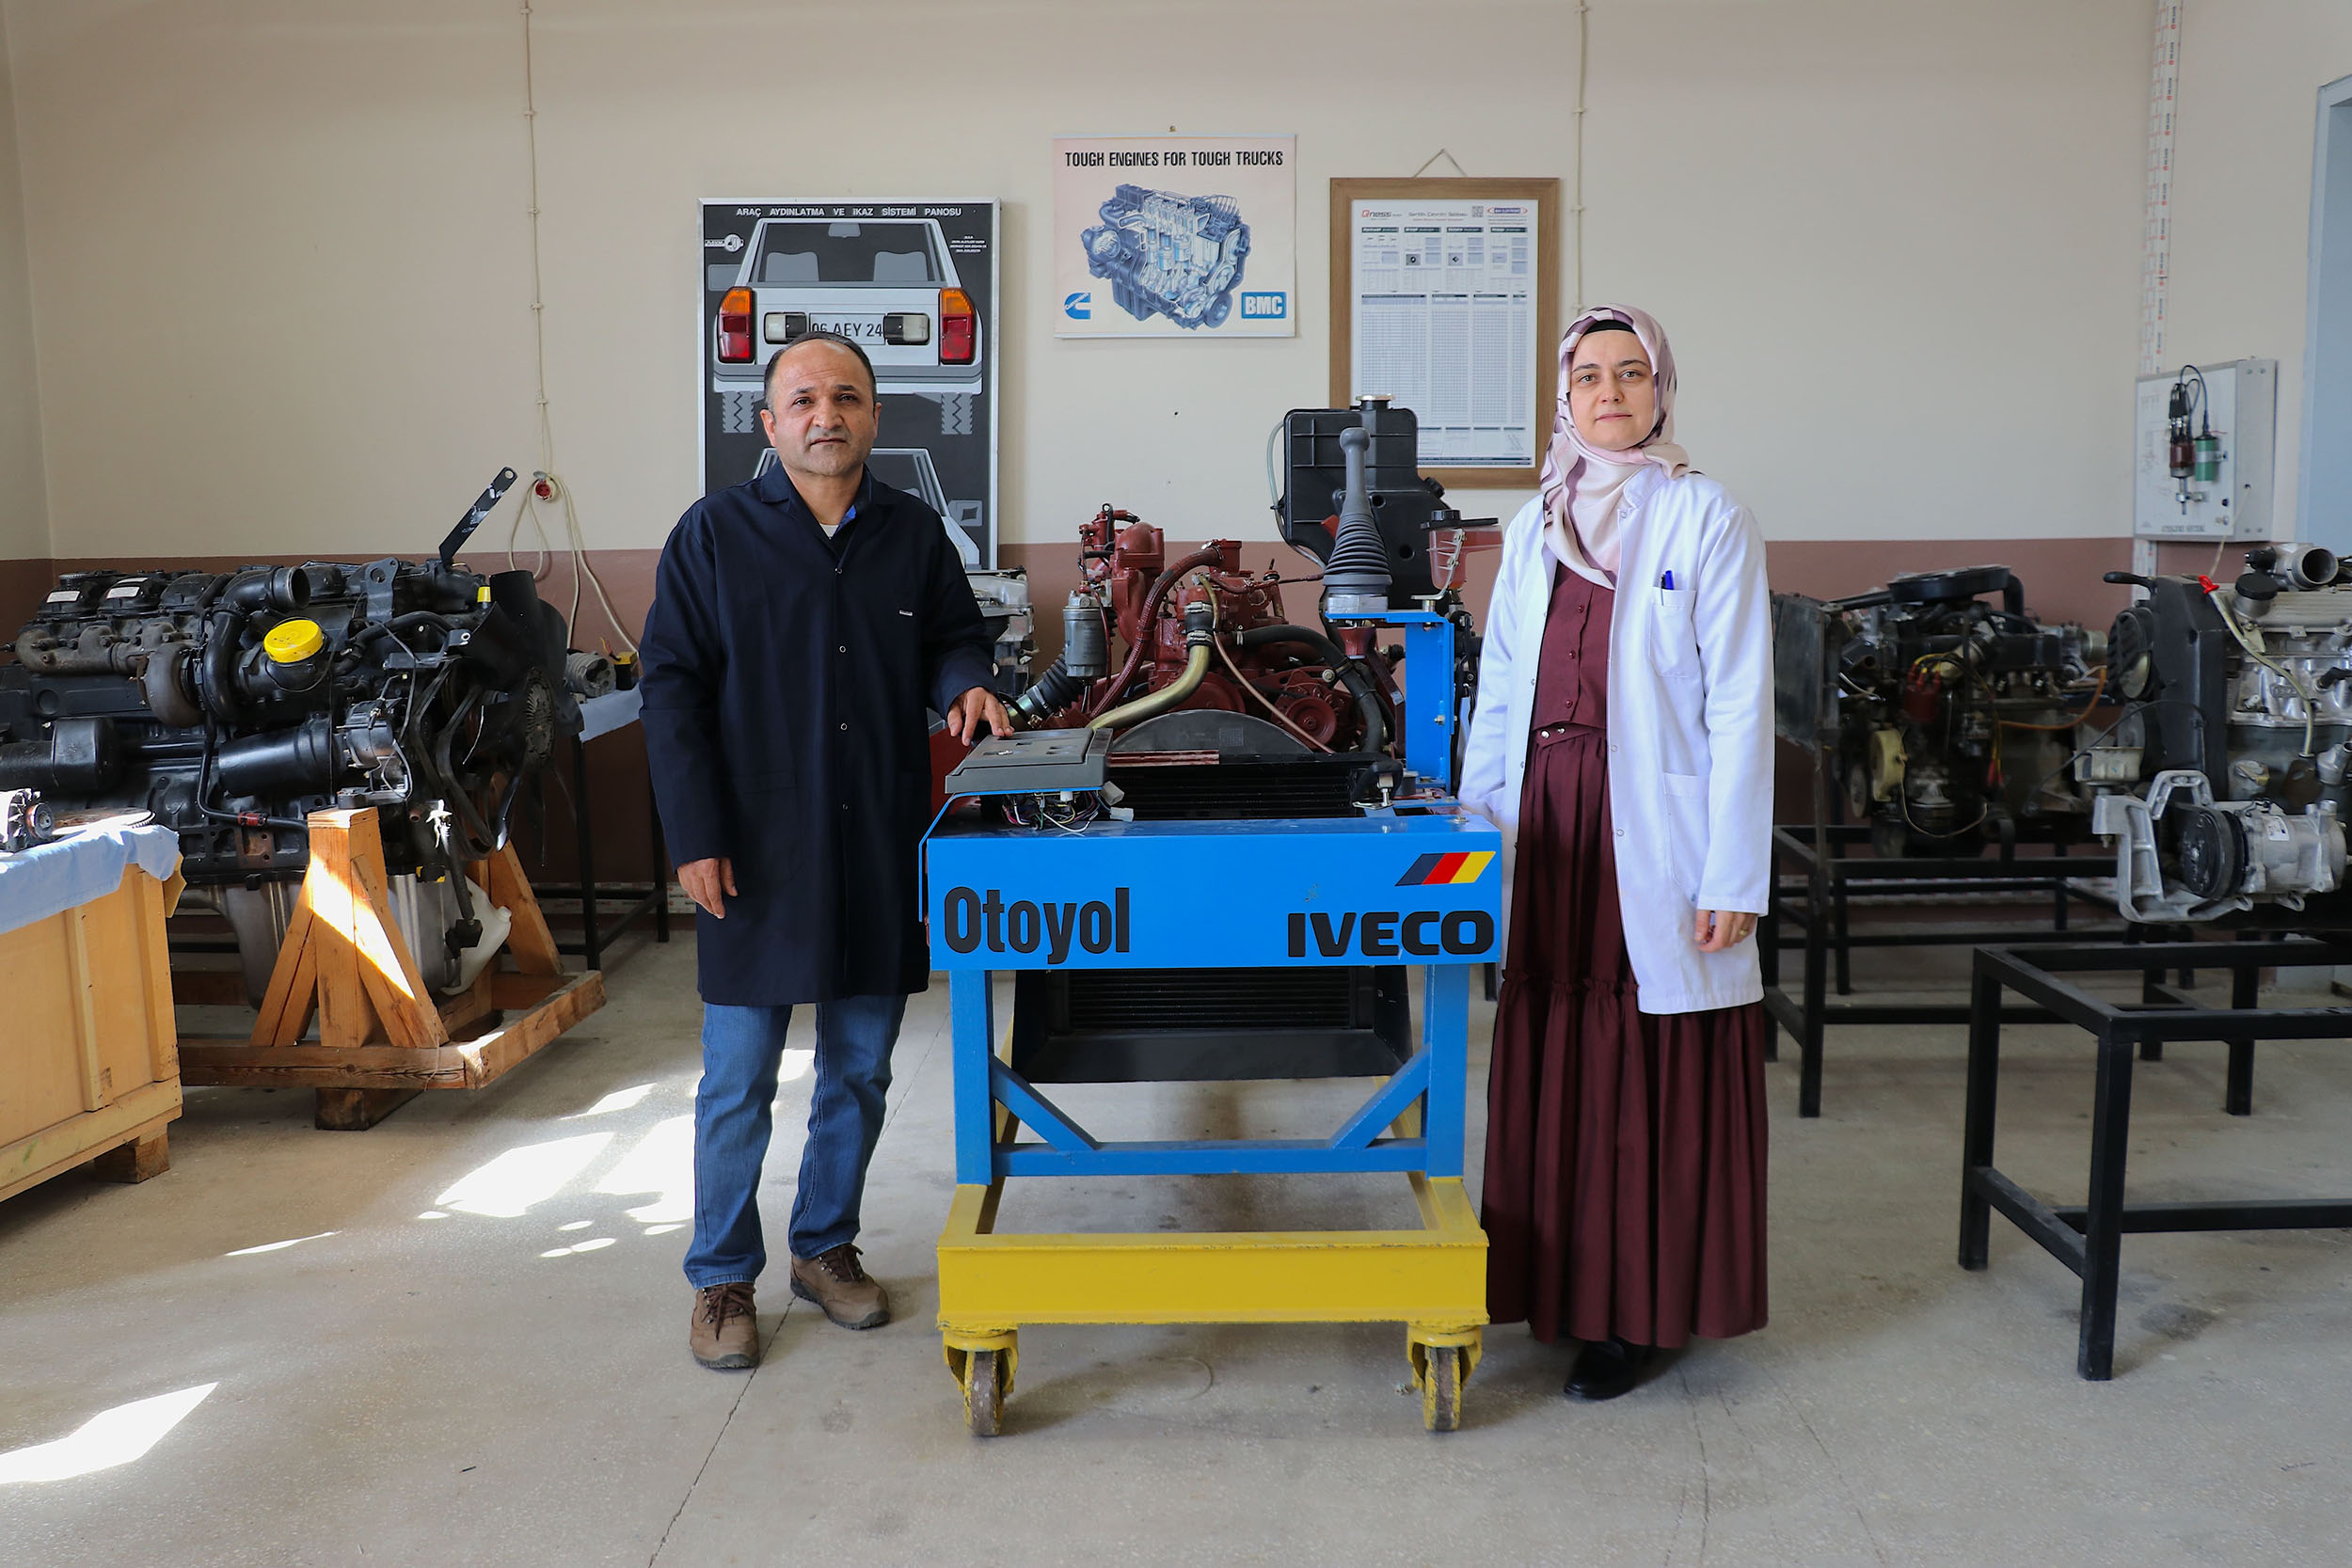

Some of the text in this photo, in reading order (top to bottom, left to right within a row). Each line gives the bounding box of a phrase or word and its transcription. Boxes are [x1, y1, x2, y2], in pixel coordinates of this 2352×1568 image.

[1065, 150, 1283, 166] TOUGH ENGINES FOR TOUGH TRUCKS
[737, 206, 961, 217] ARAÇ AYDINLATMA VE İKAZ SİSTEMİ PANOSU
[1245, 295, 1282, 314] BMC
[834, 323, 862, 337] AEY
[866, 324, 882, 337] 24
[944, 887, 1130, 964] Otoyol
[1288, 910, 1495, 958] IVECO
